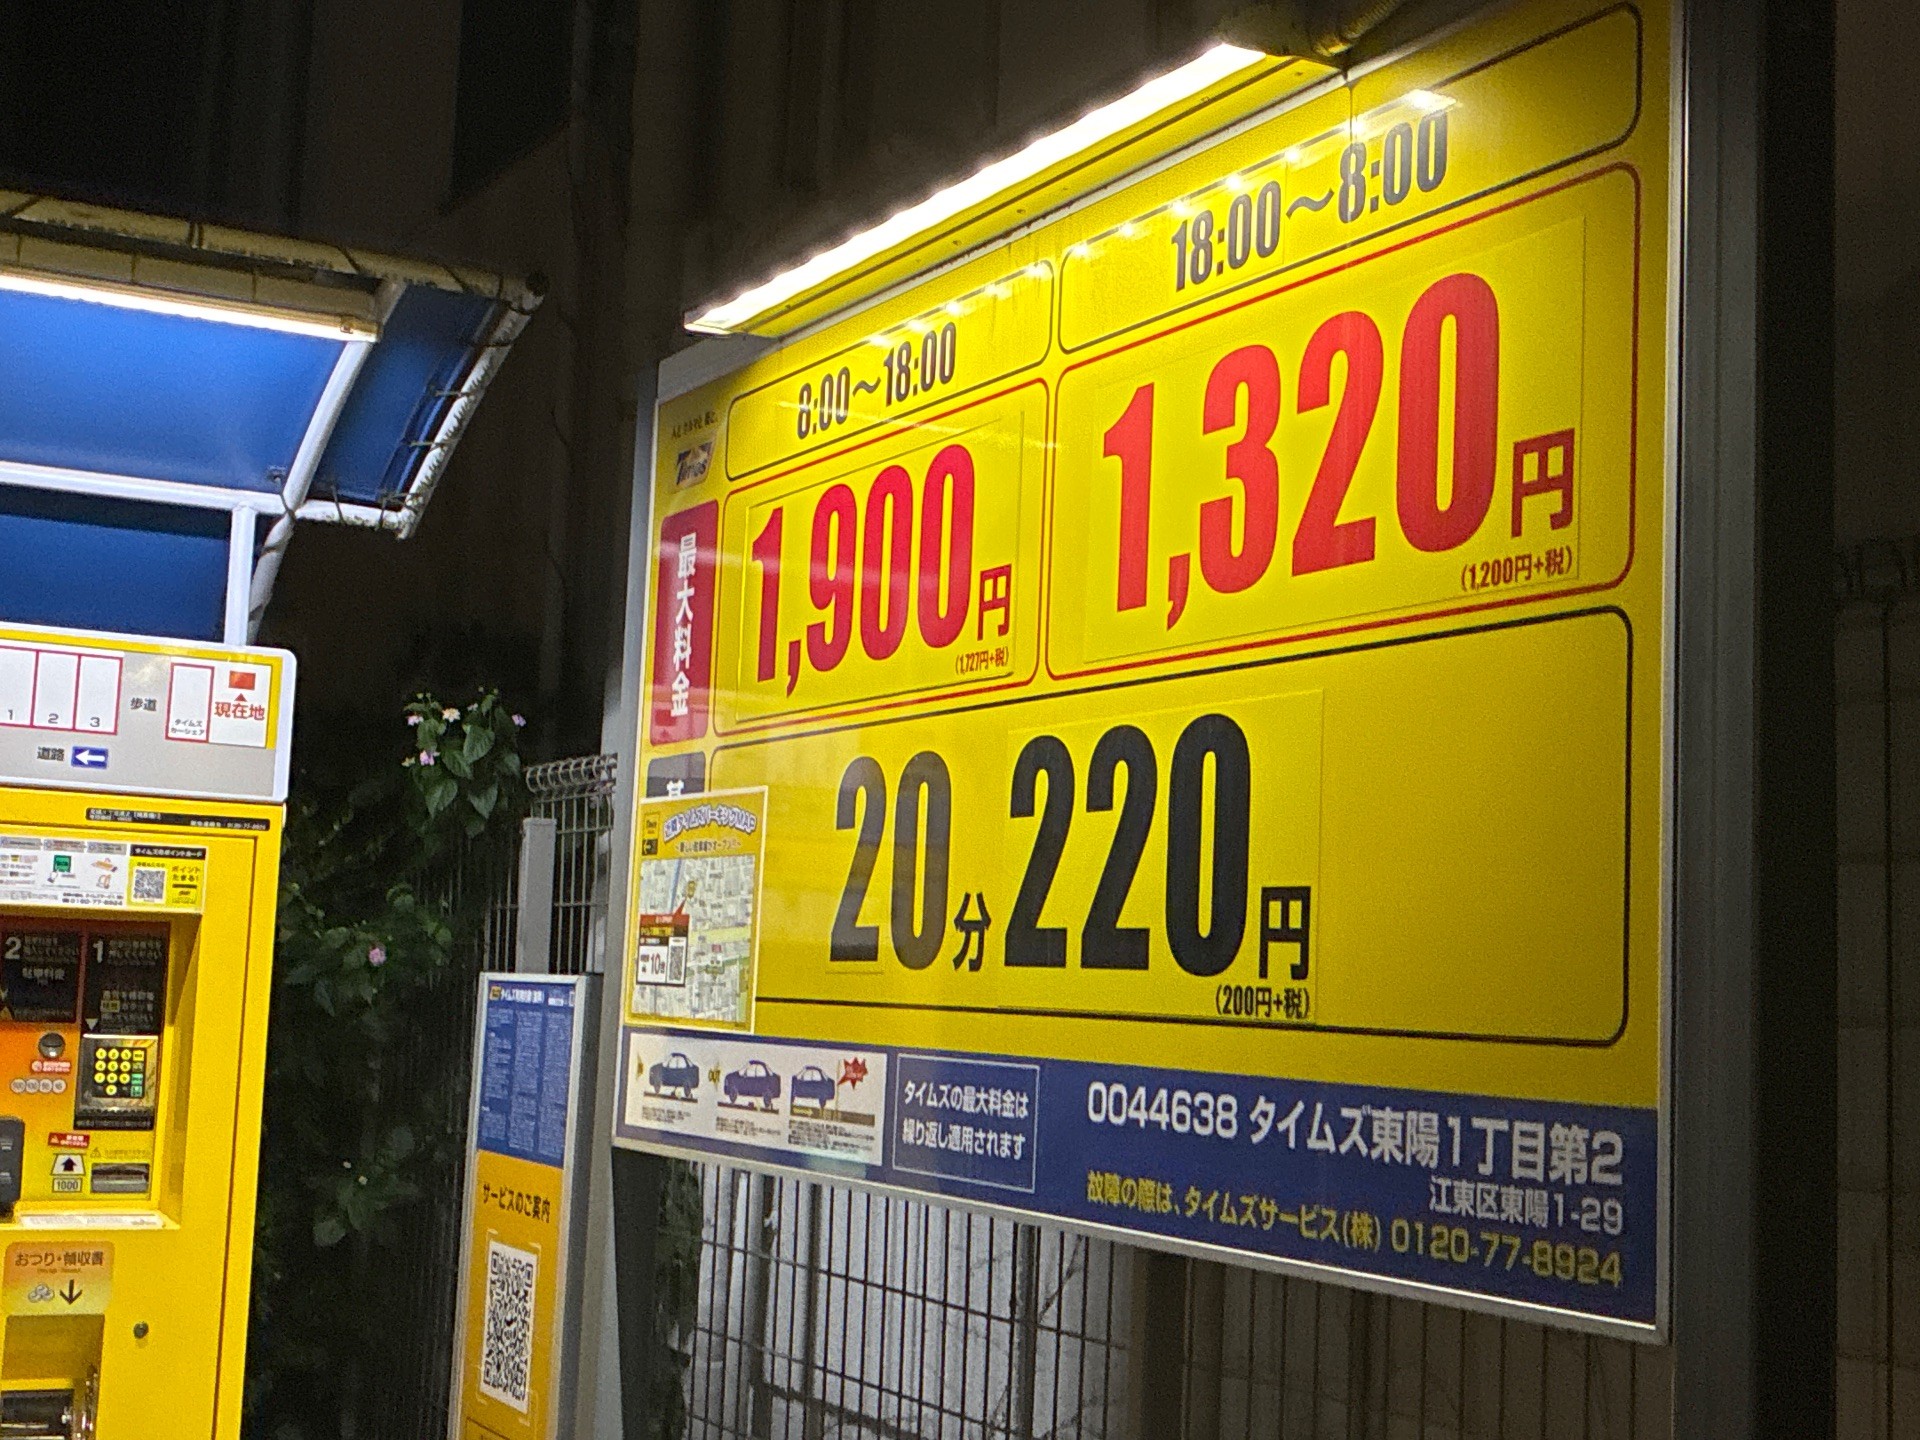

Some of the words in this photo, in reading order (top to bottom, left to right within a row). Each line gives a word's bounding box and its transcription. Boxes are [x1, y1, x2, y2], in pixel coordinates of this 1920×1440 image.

[1103, 272, 1575, 631] 1,320円
[752, 444, 1012, 698] 1,900円
[1461, 545, 1573, 592] (1,200円+税)
[670, 532, 697, 717] 最大料金
[7, 709, 14, 721] 1
[47, 713, 60, 725] 2
[89, 716, 101, 728] 3
[130, 697, 158, 712] 歩道
[214, 701, 266, 721] 現在地
[36, 746, 65, 761] 道路
[829, 750, 992, 972] 20分
[1004, 712, 1311, 980] 220円
[4, 936, 22, 960] 2
[92, 939, 104, 963] 1
[1216, 984, 1310, 1019] (200円+税)
[904, 1079, 1029, 1119] タイムズの最大料金は
[902, 1117, 1026, 1160] 繰り返し適用されます
[1088, 1081, 1238, 1139] 0044638
[1249, 1095, 1623, 1187] タイムズ東陽1丁目第2
[56, 1180, 79, 1190] 1000
[482, 1182, 551, 1224] サービスのご案内
[1429, 1175, 1623, 1236] 江東区東陽1-29
[1391, 1218, 1622, 1289] 0120-77-8924
